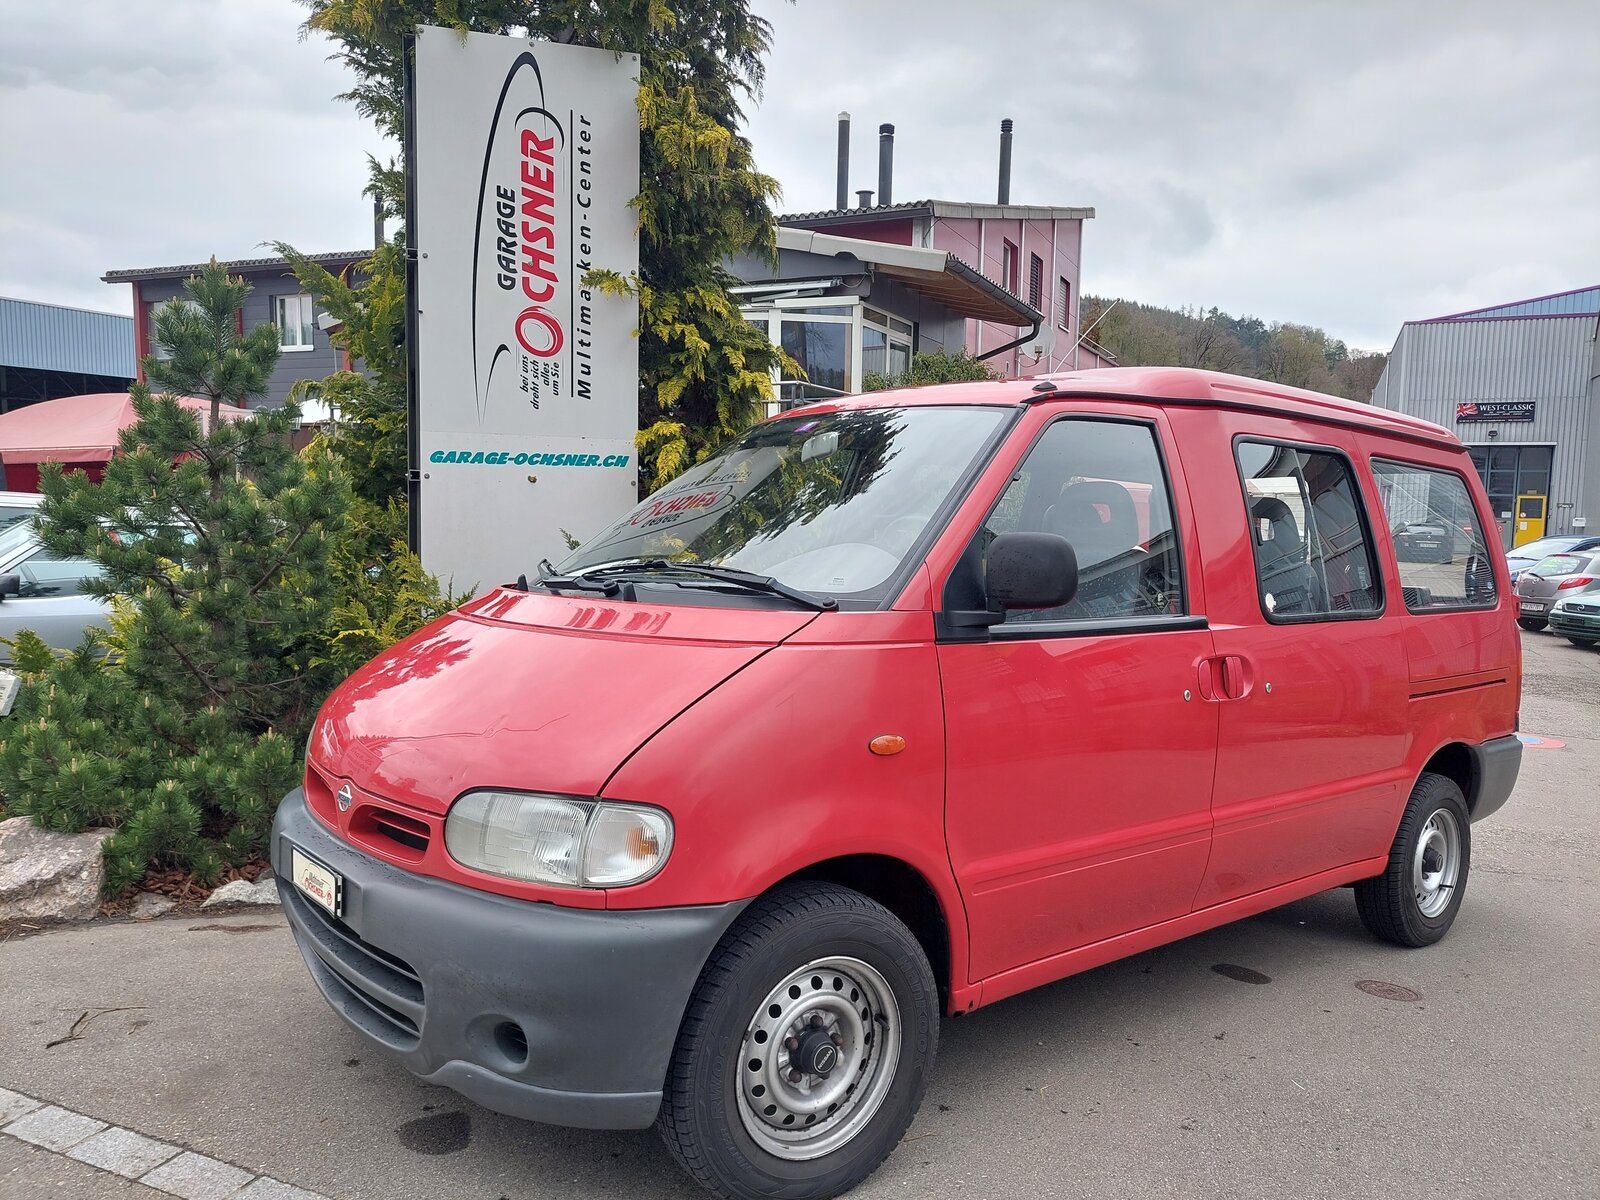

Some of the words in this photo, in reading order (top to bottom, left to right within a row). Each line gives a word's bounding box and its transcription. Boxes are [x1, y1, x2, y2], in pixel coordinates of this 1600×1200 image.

[497, 185, 518, 291] GARAGE
[515, 128, 563, 358] OCHSNER
[577, 115, 592, 400] Multimaken-Center
[530, 360, 539, 380] sich
[540, 362, 550, 386] alles
[550, 362, 560, 378] Sie
[520, 374, 529, 393] bei
[553, 380, 559, 396] um
[530, 381, 539, 410] dreht
[1480, 403, 1535, 412] WEST-CLASSIC
[430, 450, 630, 467] GARAGE-OCHSNER.CH
[817, 1049, 833, 1069] NISSAN
